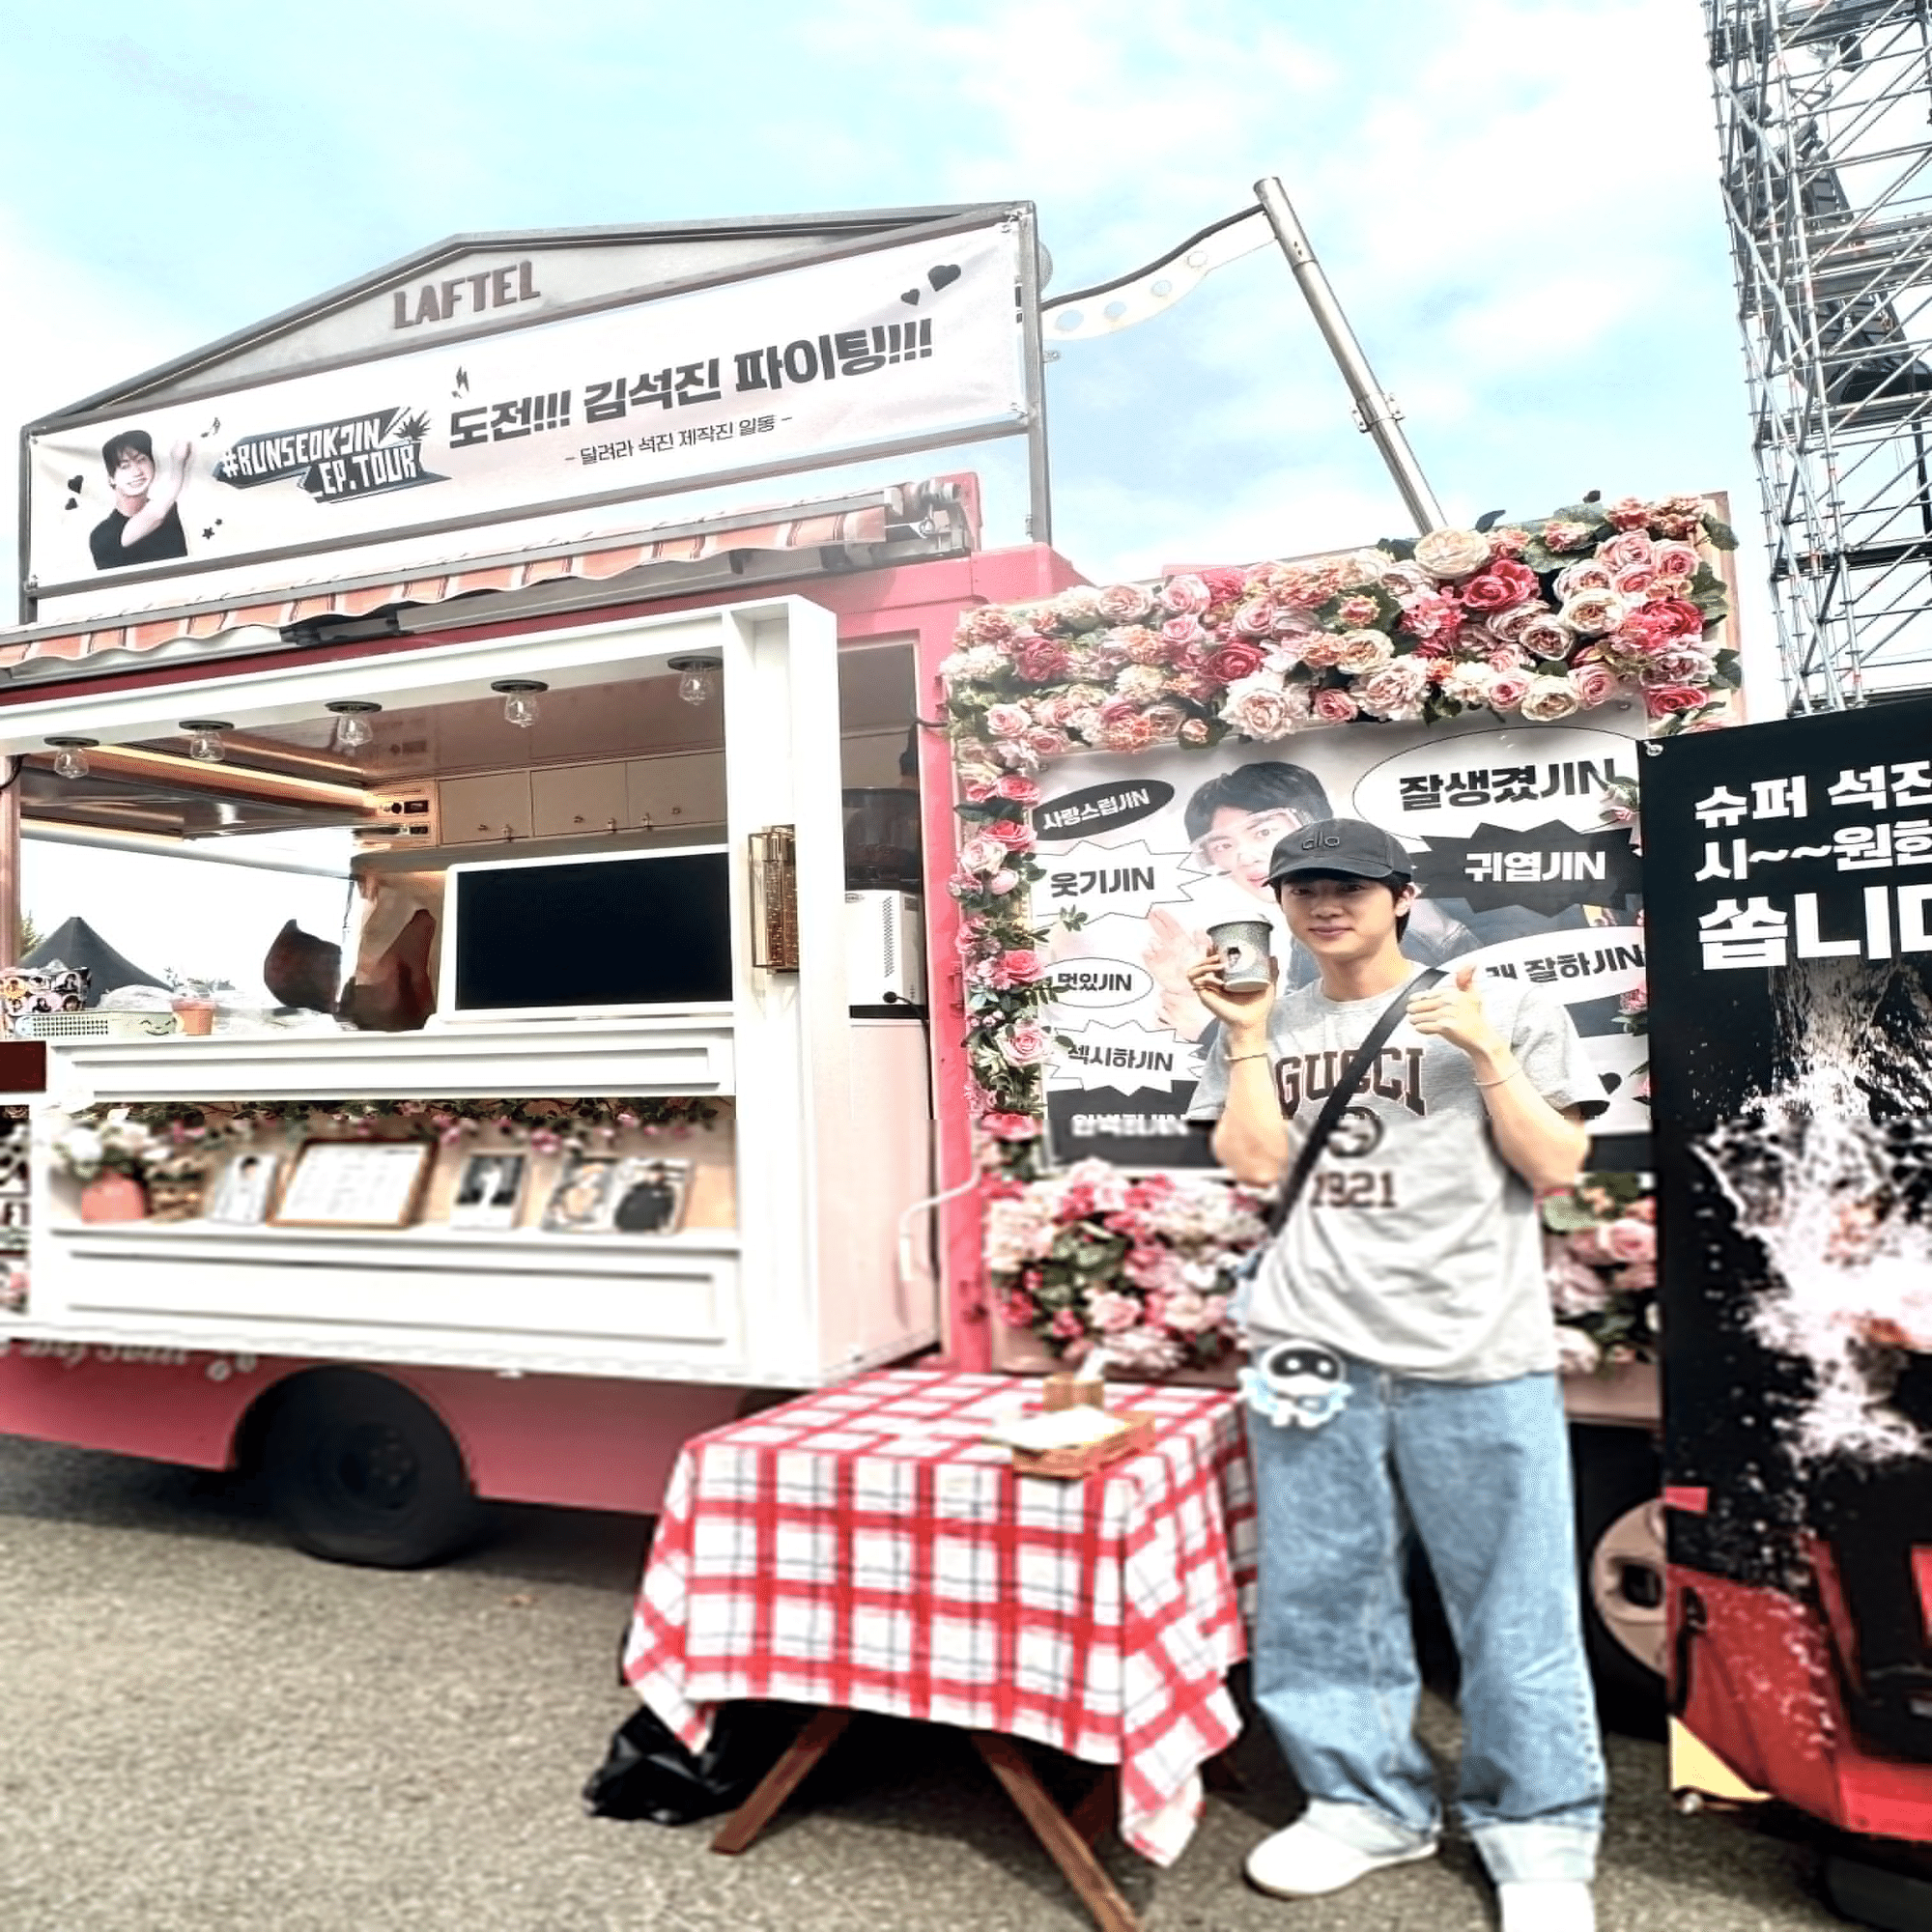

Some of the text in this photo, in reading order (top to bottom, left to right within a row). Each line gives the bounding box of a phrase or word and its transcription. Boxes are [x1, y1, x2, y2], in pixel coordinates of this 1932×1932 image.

[394, 261, 541, 328] LAFTEL
[449, 318, 933, 448] 도전!!! 김석진 파이팅!!!
[580, 440, 634, 466] 달려라
[638, 433, 674, 453] 석진
[678, 422, 733, 447] 제작진
[738, 414, 777, 436] 일동
[1043, 787, 1151, 830] 사랑스럽JIN
[1694, 775, 1808, 829] 슈퍼
[1050, 867, 1154, 898] 웃기JIN
[1463, 851, 1606, 883] 귀엽JIN
[1057, 973, 1132, 991] 멋있JIN
[1523, 943, 1644, 983] 잘하JIN
[1067, 1044, 1174, 1072] 섹시하JIN
